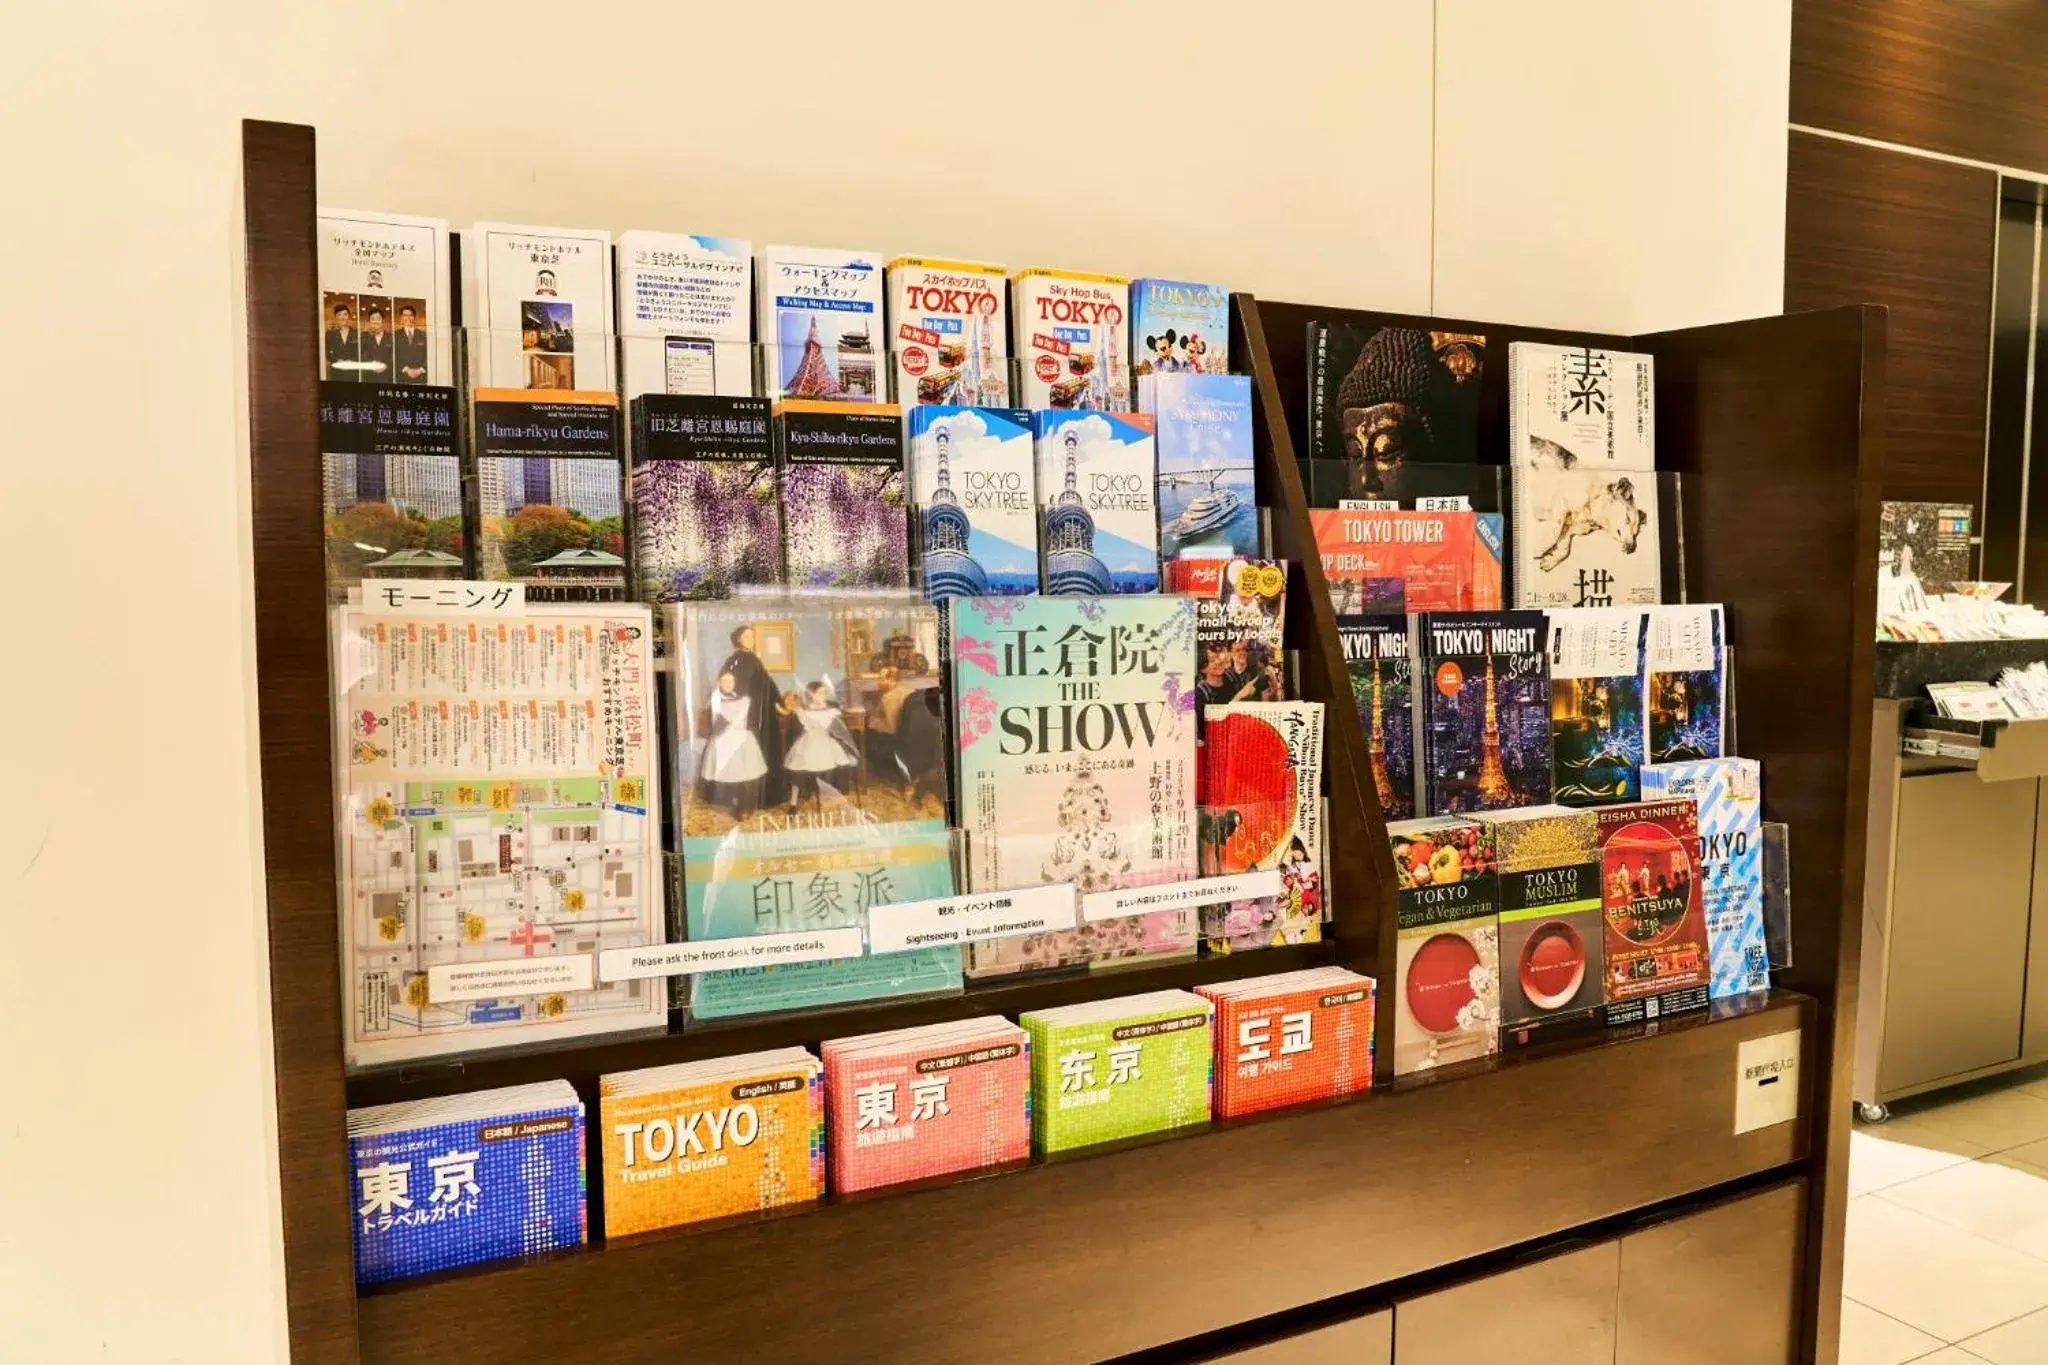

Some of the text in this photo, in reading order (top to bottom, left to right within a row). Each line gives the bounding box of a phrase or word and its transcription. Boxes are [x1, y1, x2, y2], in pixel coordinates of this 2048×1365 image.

[794, 286, 858, 298] アクセスマップ
[907, 286, 998, 316] TOKYO
[1049, 285, 1111, 300] Sky Hop Bus
[1037, 297, 1123, 325] TOKYO
[1567, 347, 1608, 415] 素
[485, 423, 610, 441] Hama-rikyu Gardens
[651, 418, 767, 435] 旧芝離宮恩賜庭園
[860, 433, 897, 446] Gardens
[963, 470, 1021, 491] TOKYO
[1089, 473, 1143, 492] TOKYO
[965, 491, 1029, 511] SKYTREE
[1089, 493, 1149, 512] SKYTREE
[1425, 498, 1461, 512] 日本語
[1343, 519, 1444, 544] TOKYO TOWER
[1337, 554, 1365, 571] DECK
[381, 586, 513, 609] モーニング
[1196, 631, 1225, 641] ours
[1227, 630, 1243, 642] by
[1338, 633, 1371, 660] KYO
[1433, 628, 1536, 655] TOKYO NIGHT
[996, 623, 1160, 678] 正倉院
[1508, 653, 1543, 681] Story
[1057, 682, 1101, 701] THE
[999, 701, 1167, 755] SHOW
[1308, 709, 1320, 767] Traditional
[1600, 810, 1638, 823] EISHA
[1700, 832, 1747, 861] OKYO
[1525, 869, 1578, 888] TOKYO
[753, 865, 894, 927] 印象派
[1414, 885, 1469, 905] TOKYO
[1525, 884, 1578, 901] MUSLIM
[937, 898, 1013, 917] 観光・イベント情報
[1398, 901, 1493, 927] egan & Vegetarian
[1608, 896, 1683, 917] BENITSUYA
[905, 919, 1045, 945] Sightseeing Event Information
[632, 956, 663, 967] Please
[665, 952, 682, 965] ask
[684, 950, 700, 962] the
[701, 948, 726, 961] front
[751, 945, 765, 956] for
[766, 944, 791, 954] more
[1237, 1011, 1314, 1063] 도쿄
[1059, 1041, 1144, 1094] 东京
[1237, 1058, 1293, 1078] 여행 가이드
[738, 1082, 773, 1098] English
[854, 1073, 951, 1130] 東京
[484, 1120, 568, 1140] 日本語 Japanese
[615, 1103, 760, 1167] TOKYO
[619, 1154, 729, 1183] Travel Guide
[357, 1149, 482, 1217] 東京
[362, 1199, 479, 1234] トラベルガイド
